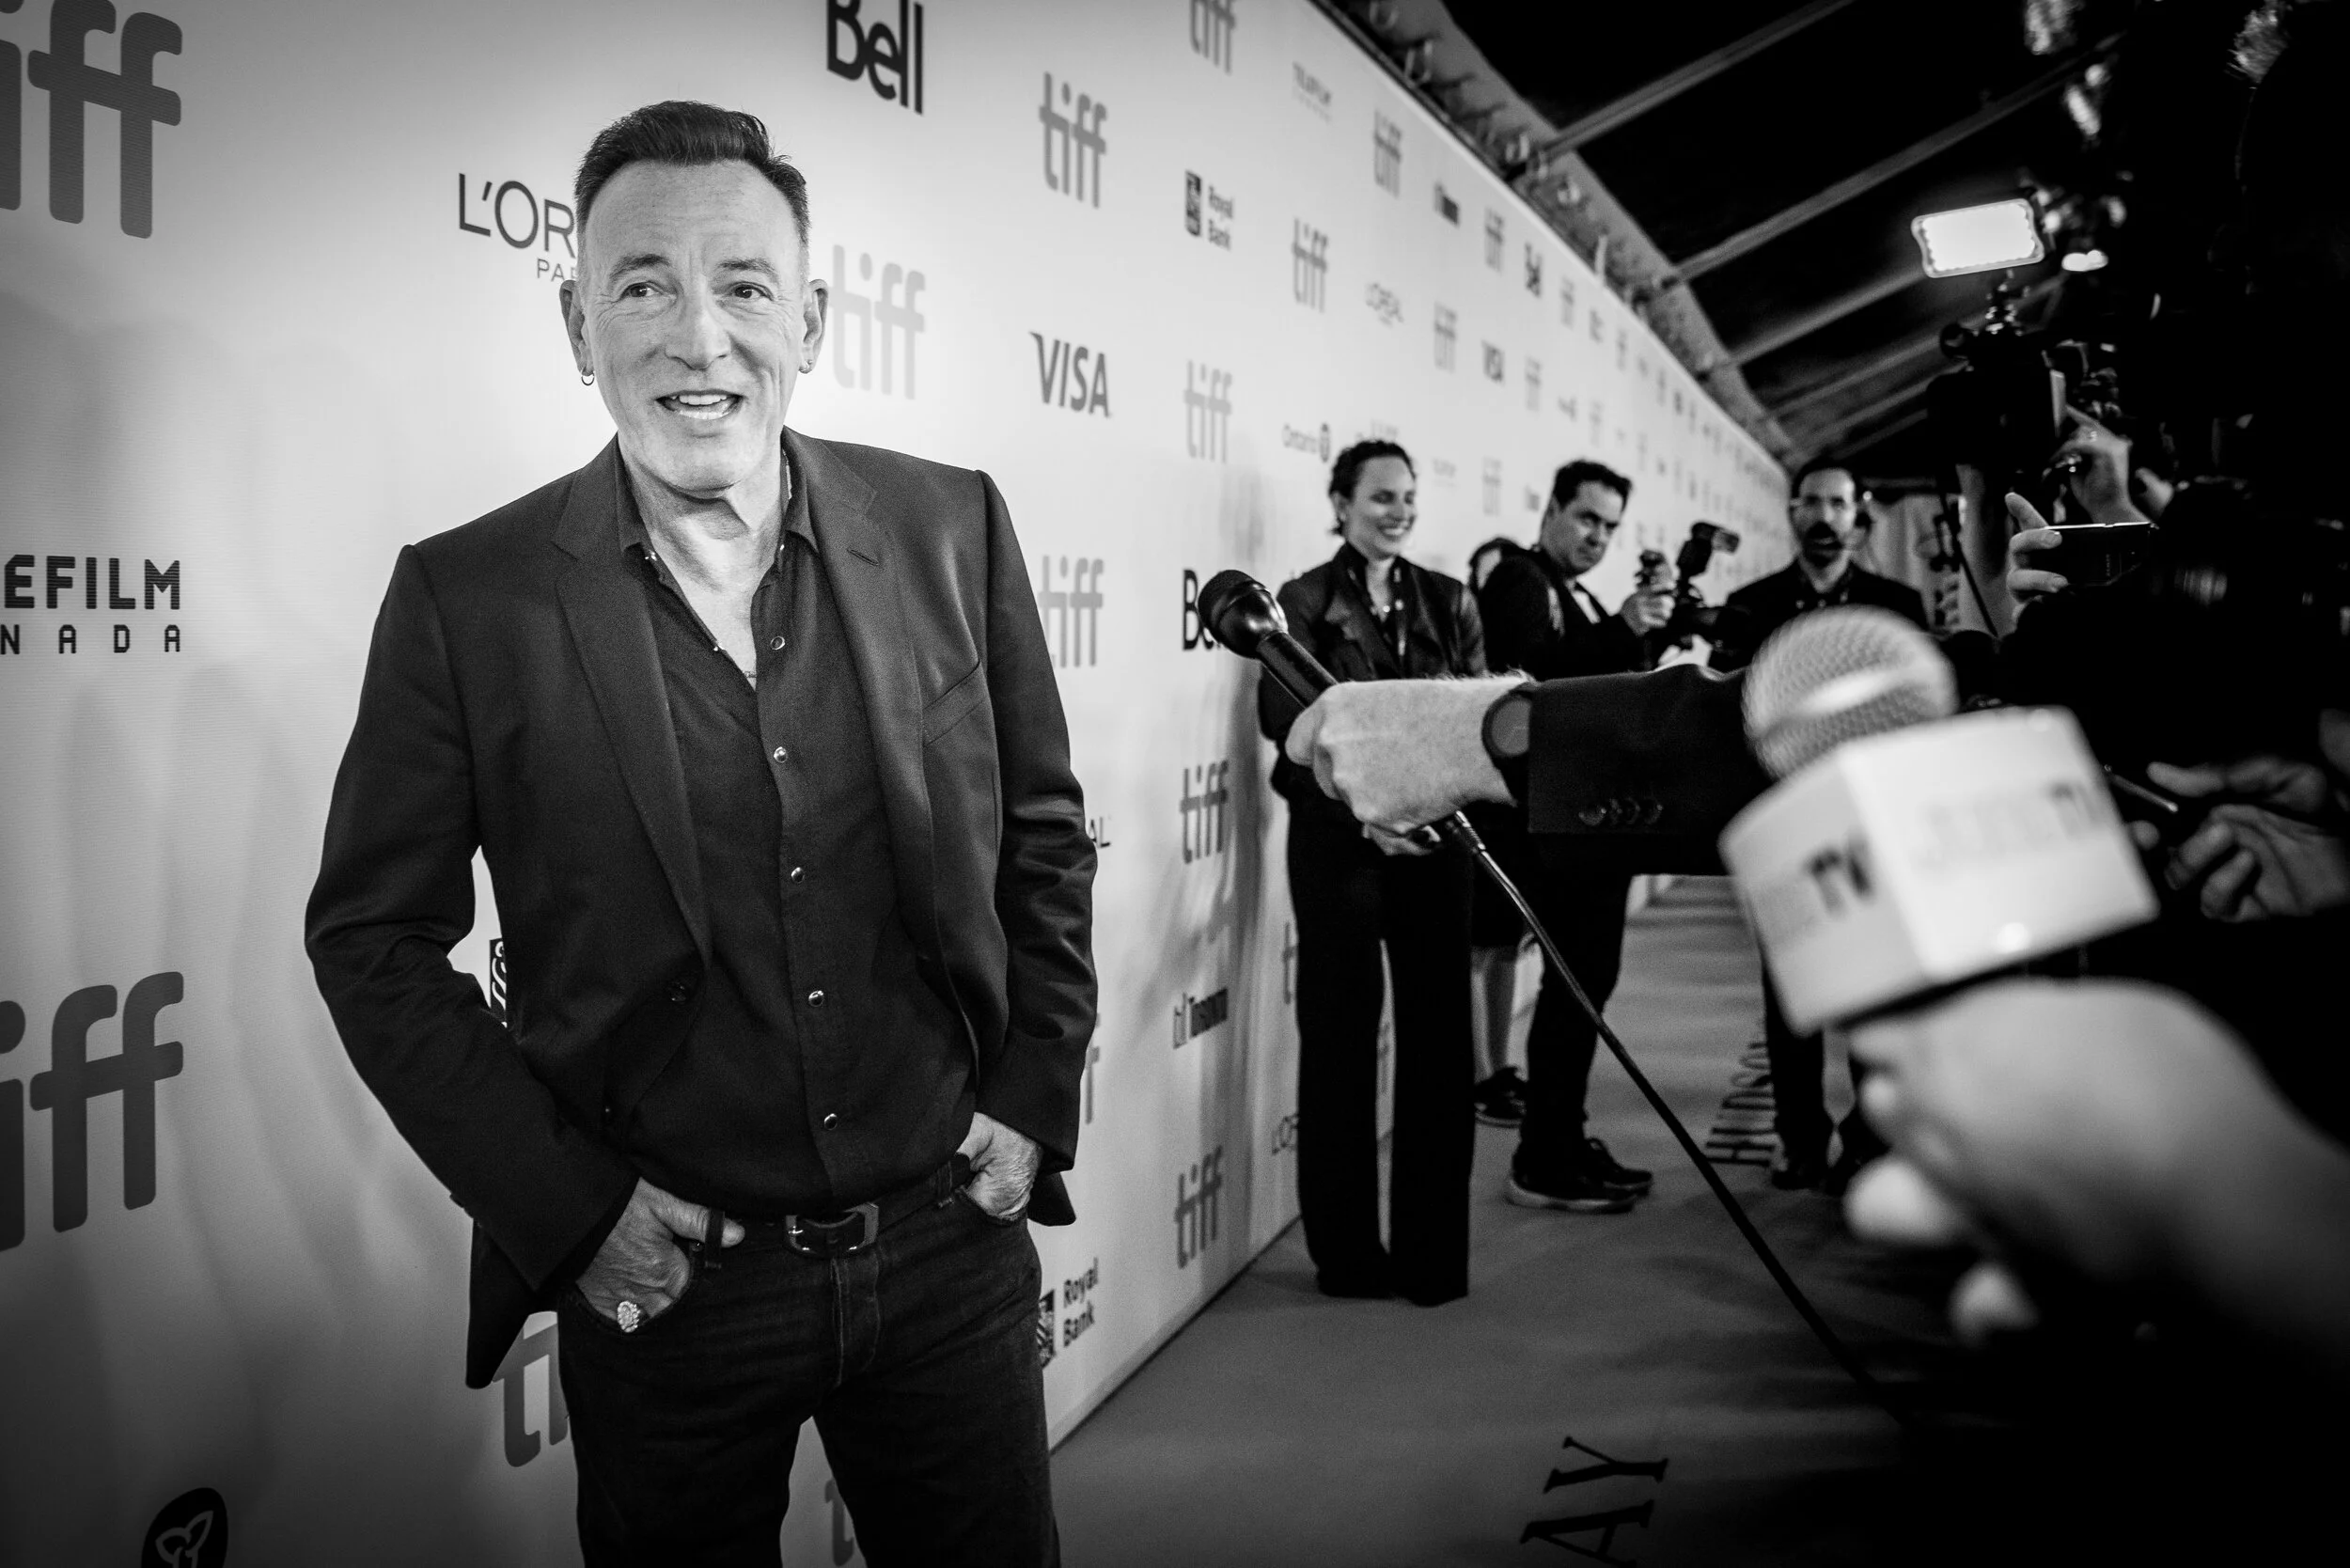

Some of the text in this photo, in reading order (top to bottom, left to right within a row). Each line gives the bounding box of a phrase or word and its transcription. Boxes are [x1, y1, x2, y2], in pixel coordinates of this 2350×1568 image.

[826, 0, 924, 116] Bell
[0, 0, 182, 239] iff
[1039, 71, 1107, 208] tiff
[458, 172, 575, 259] L'OR
[1292, 217, 1328, 313] tiff
[829, 244, 926, 400] tiff
[1029, 331, 1111, 417] VISA
[1183, 361, 1232, 463] tiff
[2, 554, 181, 610] EFILM
[1038, 555, 1104, 669] tiff
[0, 623, 180, 655] NADA
[1180, 760, 1228, 864] tiff
[0, 971, 184, 1252] iff
[1174, 1146, 1223, 1269] tiff
[1063, 1257, 1098, 1309] Royal
[1063, 1300, 1095, 1348] Bank
[1519, 1435, 1668, 1568] AY
